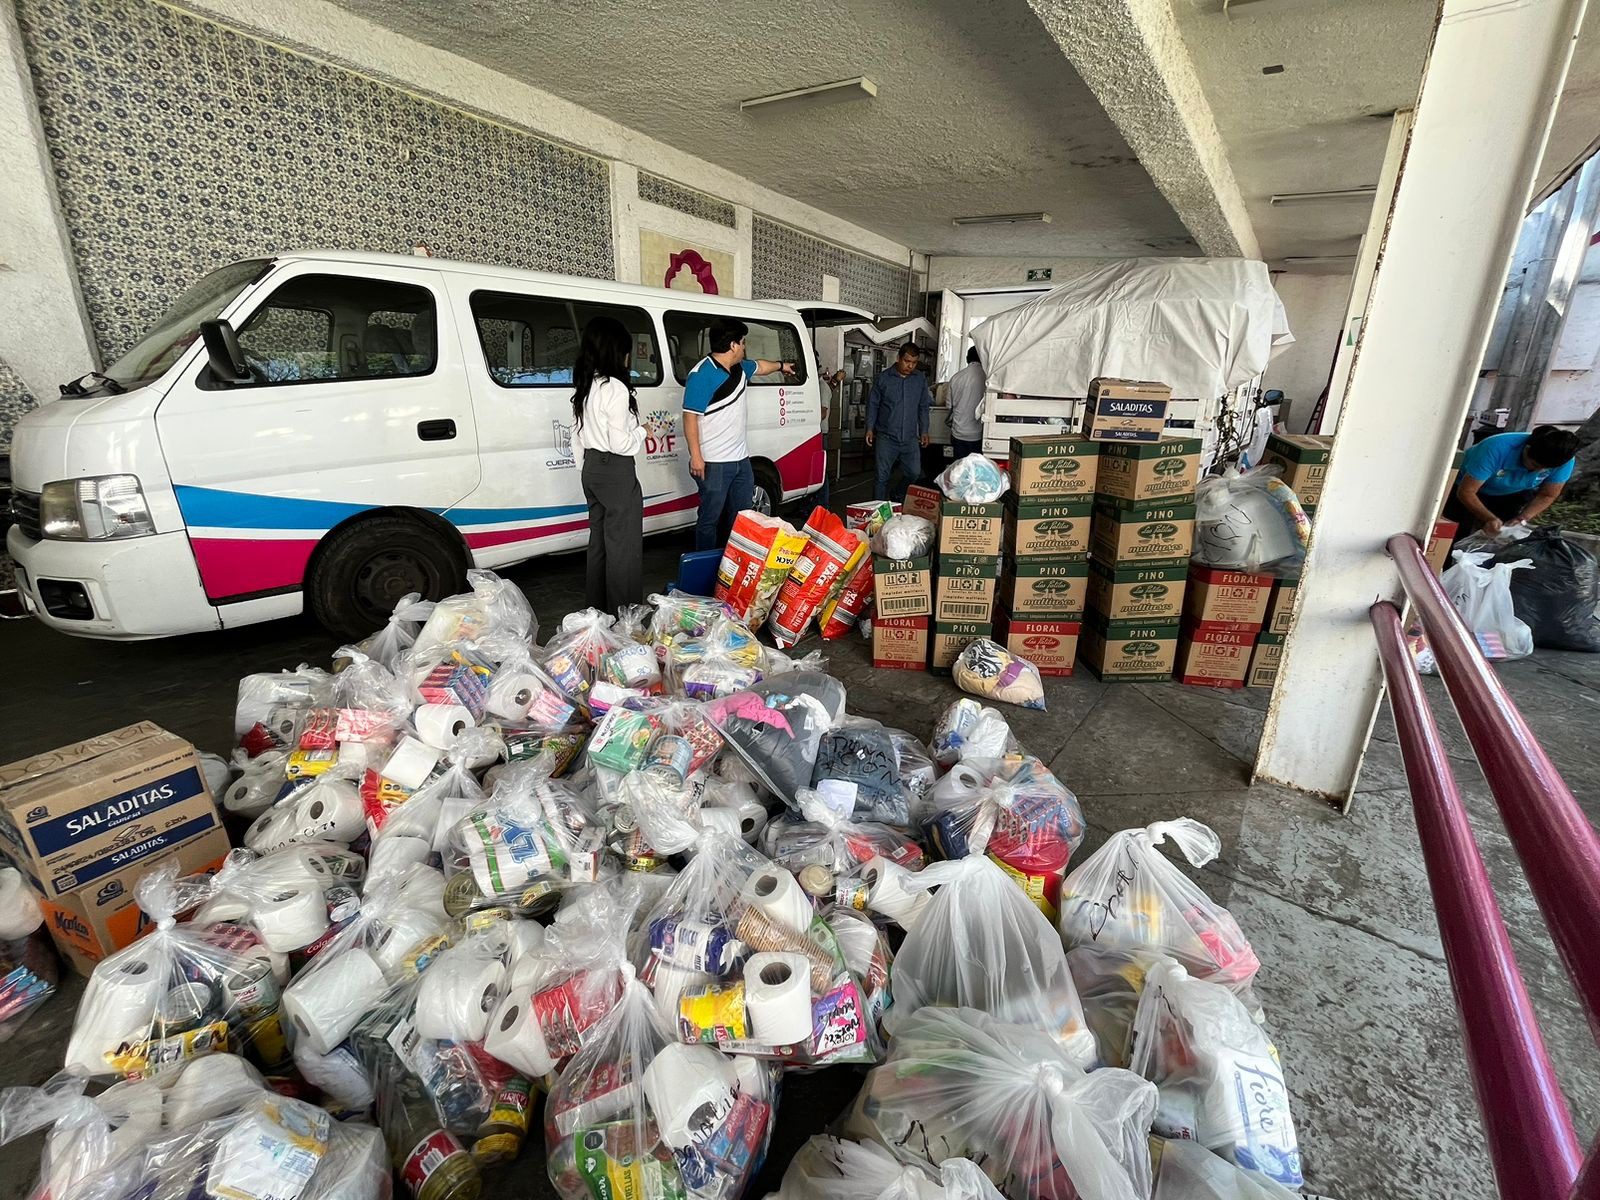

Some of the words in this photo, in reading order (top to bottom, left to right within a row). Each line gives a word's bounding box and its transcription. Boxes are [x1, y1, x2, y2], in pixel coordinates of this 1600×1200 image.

[1110, 402, 1152, 413] SALADITAS
[1047, 445, 1075, 454] PINO
[1161, 444, 1184, 454] PINO
[917, 490, 938, 500] FLORAL
[961, 506, 986, 514] PINO
[1042, 508, 1068, 516] PINO
[1146, 510, 1173, 519] PINO
[890, 561, 913, 570] PINO
[956, 567, 980, 575] PINO
[1040, 567, 1066, 575] PINO
[1138, 572, 1164, 580] PINO
[1223, 575, 1259, 584] FLORAL
[1026, 624, 1060, 632] FLORAL
[1205, 633, 1241, 643] FLORAL
[1021, 654, 1064, 662] ultiusos
[66, 784, 174, 836] SALADITAS
[108, 811, 141, 828] Gamesa
[111, 836, 165, 864] SALADITAS
[306, 937, 334, 954] Colga
[622, 1169, 632, 1200] TRELLAS
